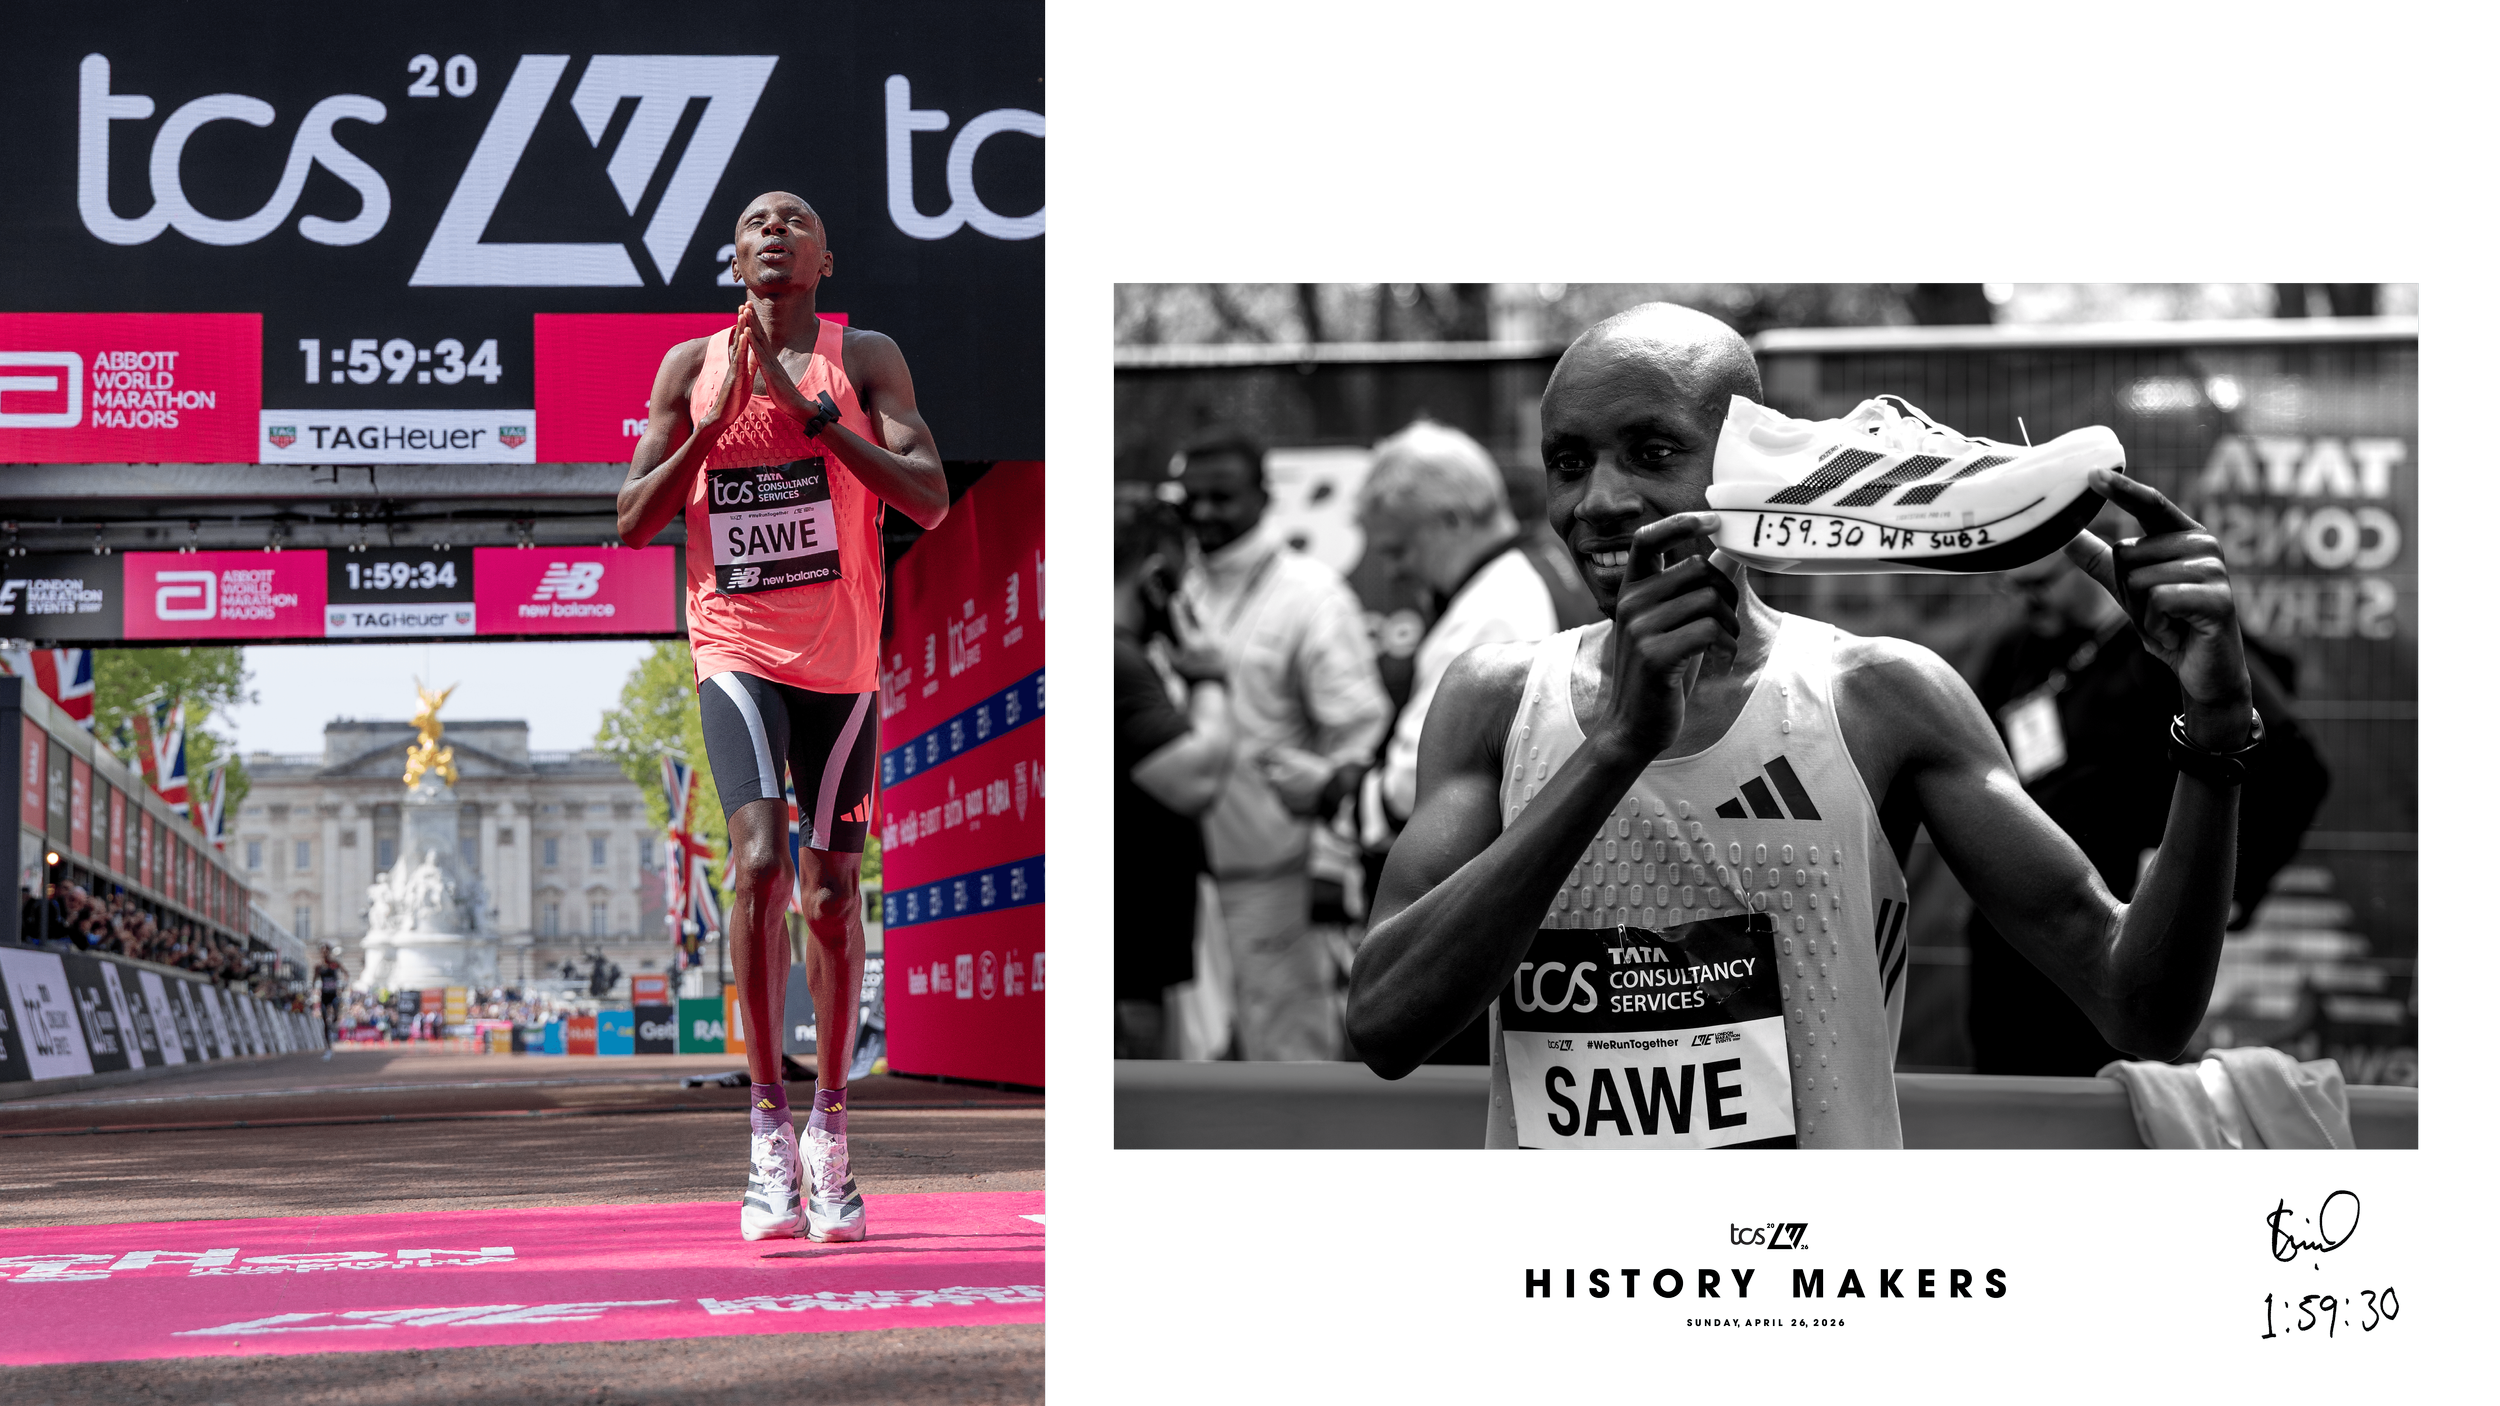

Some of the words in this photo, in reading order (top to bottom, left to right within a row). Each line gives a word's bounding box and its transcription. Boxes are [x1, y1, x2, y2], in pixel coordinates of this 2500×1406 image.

[884, 74, 1046, 241] tc
[79, 53, 391, 246] tcs
[408, 54, 478, 98] 20
[716, 243, 746, 287] 2
[93, 351, 179, 371] ABBOTT
[299, 338, 502, 384] 1:59:34
[93, 372, 174, 389] WORLD
[92, 390, 216, 410] MARATHON
[93, 410, 179, 429] MAJORS
[622, 418, 650, 437] ne
[756, 473, 784, 482] TATA
[757, 475, 820, 493] CONSULTANCY
[713, 477, 754, 505] tcs
[758, 490, 800, 502] SERVICES
[728, 518, 818, 557] SAWE
[1880, 526, 1914, 549] WR
[221, 570, 275, 584] ABBOTT
[345, 562, 457, 589] 1:59:34
[763, 576, 785, 586] new
[786, 568, 829, 583] balance
[27, 579, 83, 591] LONDON
[221, 583, 272, 595] WORLD
[27, 589, 103, 602] MARATHON
[221, 594, 298, 607] MARATHON
[27, 601, 76, 615] EVENTS
[221, 607, 275, 620] MAJORS
[518, 603, 550, 618] new
[551, 602, 615, 618] balance
[1608, 947, 1669, 965] TATA
[1609, 957, 1756, 989] CONSULTANCY
[1514, 962, 1598, 1013] tcs
[1611, 990, 1705, 1013] SERVICES
[1587, 1038, 1679, 1051] #WeRunTogether
[1545, 1057, 1747, 1137] SAWE
